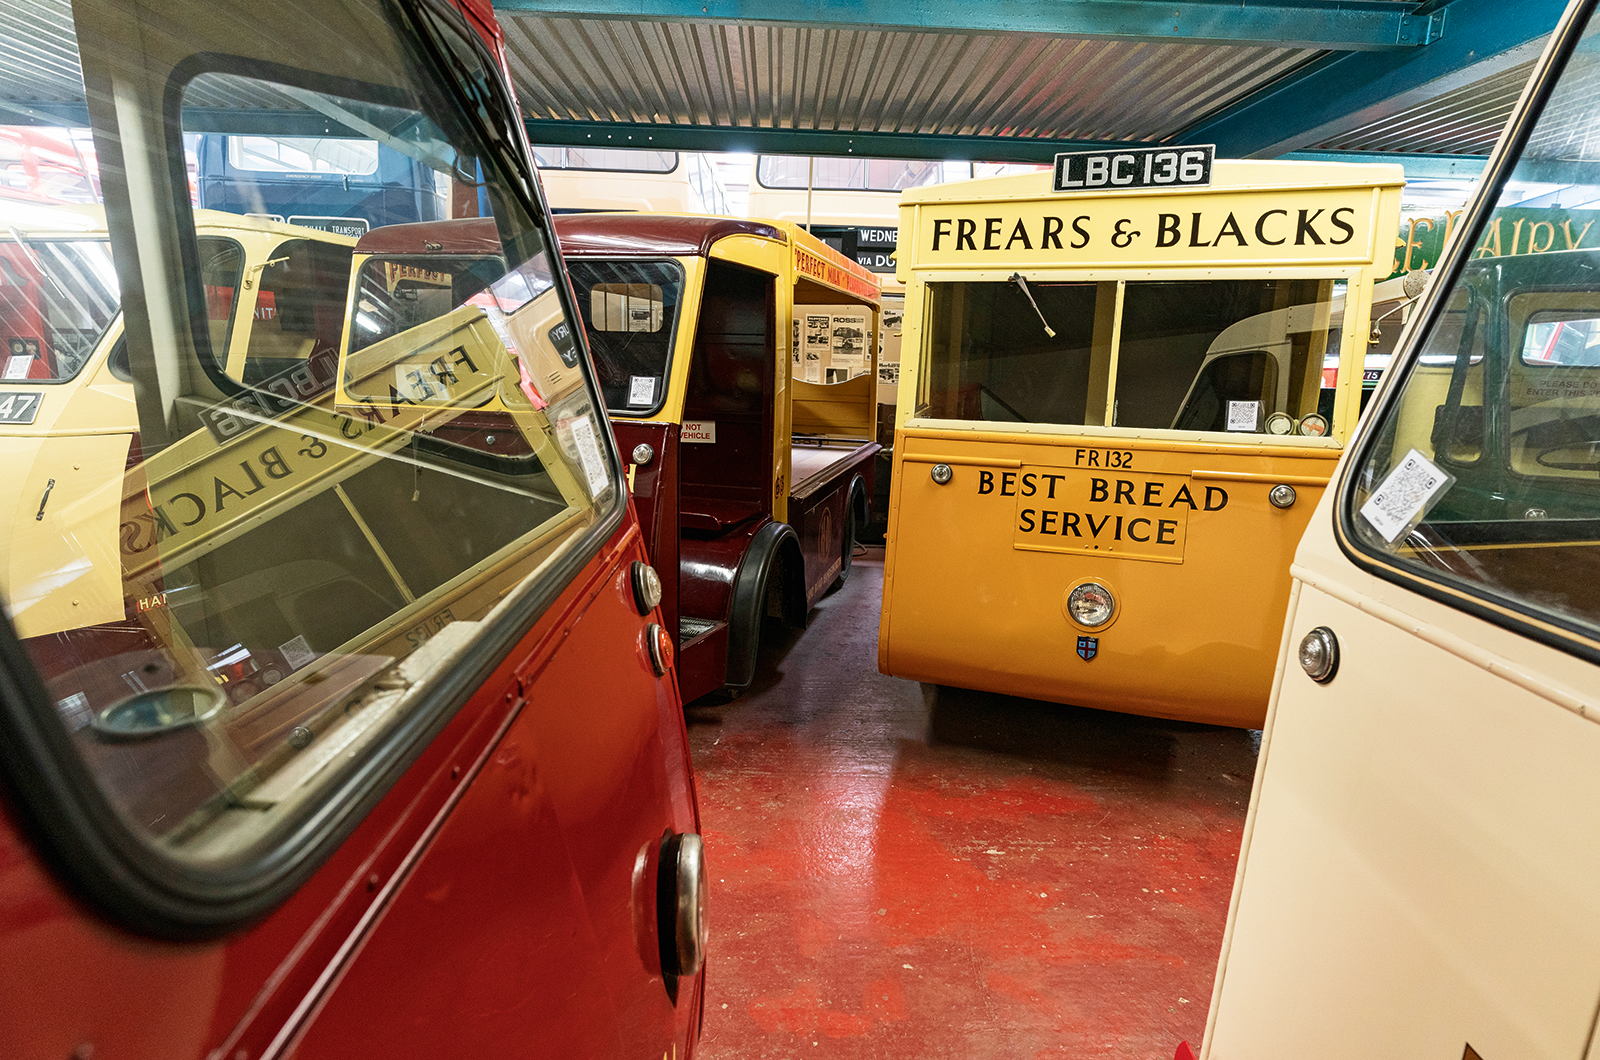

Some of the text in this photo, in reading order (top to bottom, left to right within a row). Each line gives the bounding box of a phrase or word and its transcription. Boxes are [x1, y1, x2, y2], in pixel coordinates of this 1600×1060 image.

[332, 225, 364, 236] TRANSPORT
[932, 207, 1355, 251] FREARS & BLACKS
[858, 254, 896, 267] VIA DU
[1540, 380, 1598, 389] PLEASE DO
[1526, 387, 1559, 396] ENTER
[1563, 389, 1586, 397] THIS
[977, 470, 1229, 511] BEST BREAD
[1018, 508, 1178, 545] SERVICE
